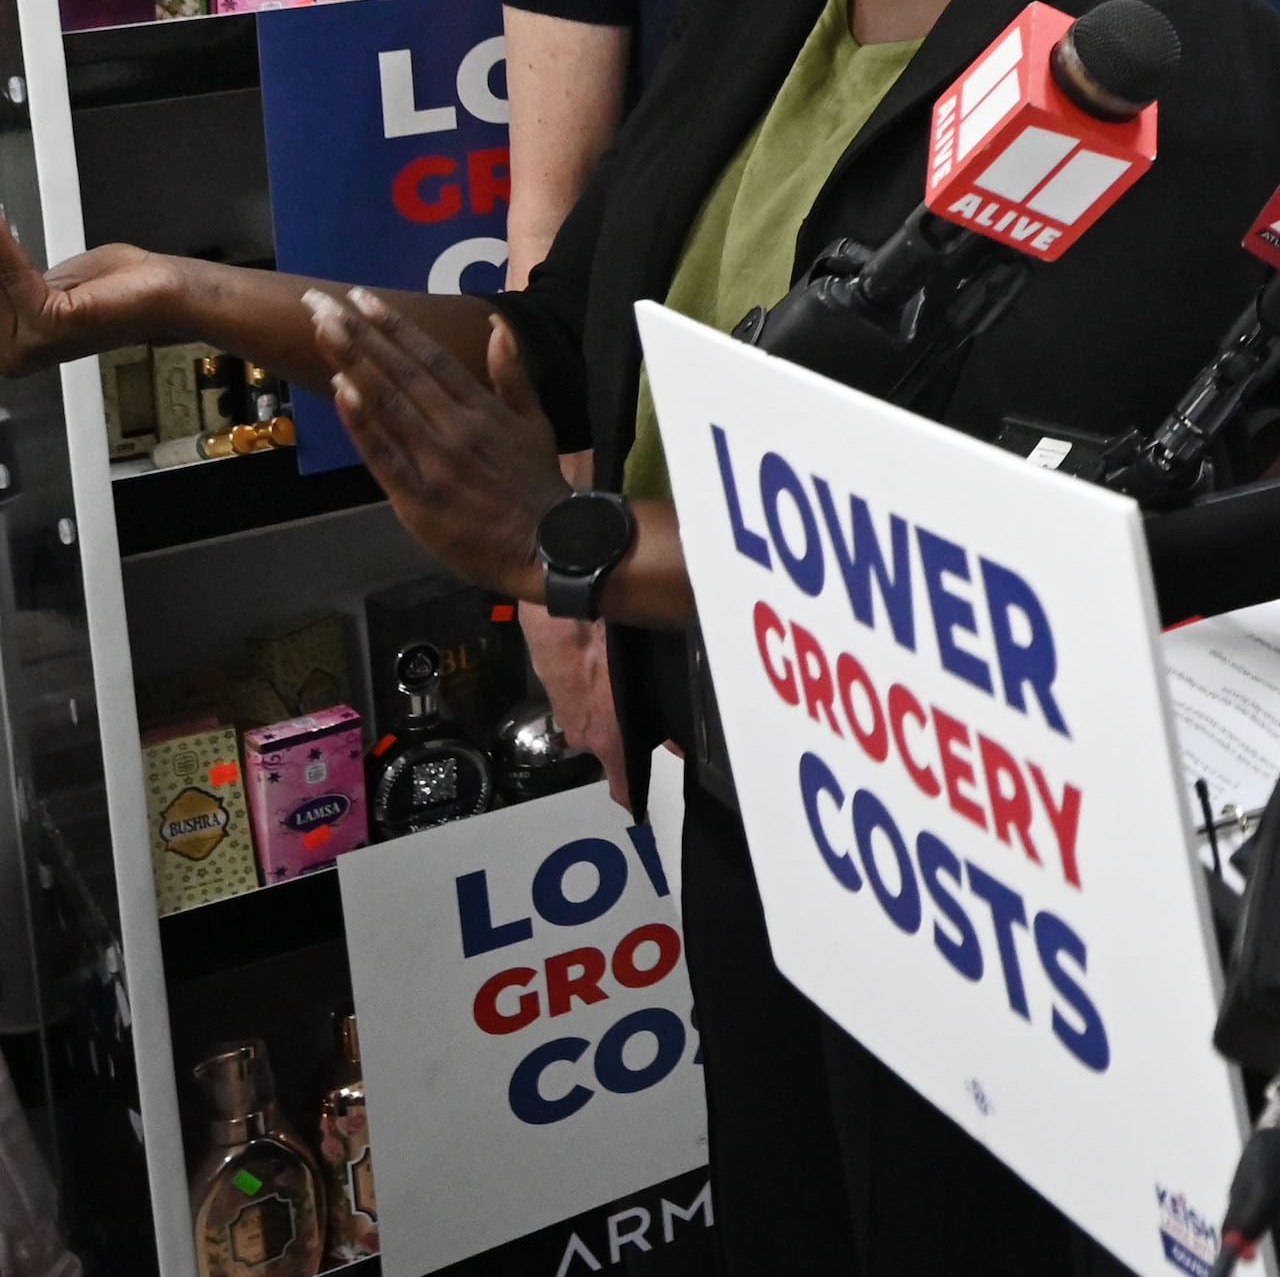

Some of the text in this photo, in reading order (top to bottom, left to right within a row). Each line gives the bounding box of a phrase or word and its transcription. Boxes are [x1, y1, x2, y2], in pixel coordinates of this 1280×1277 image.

[932, 94, 958, 189] ALIVE
[948, 192, 1064, 251] ALIVE
[709, 424, 1070, 738] LOWER
[752, 599, 1083, 890] GROCERY
[169, 813, 221, 837] BUSHRA
[295, 802, 341, 824] LAMSA
[797, 751, 1110, 1074] COSTS
[508, 1007, 704, 1125] CO
[555, 1180, 715, 1277] ARM
